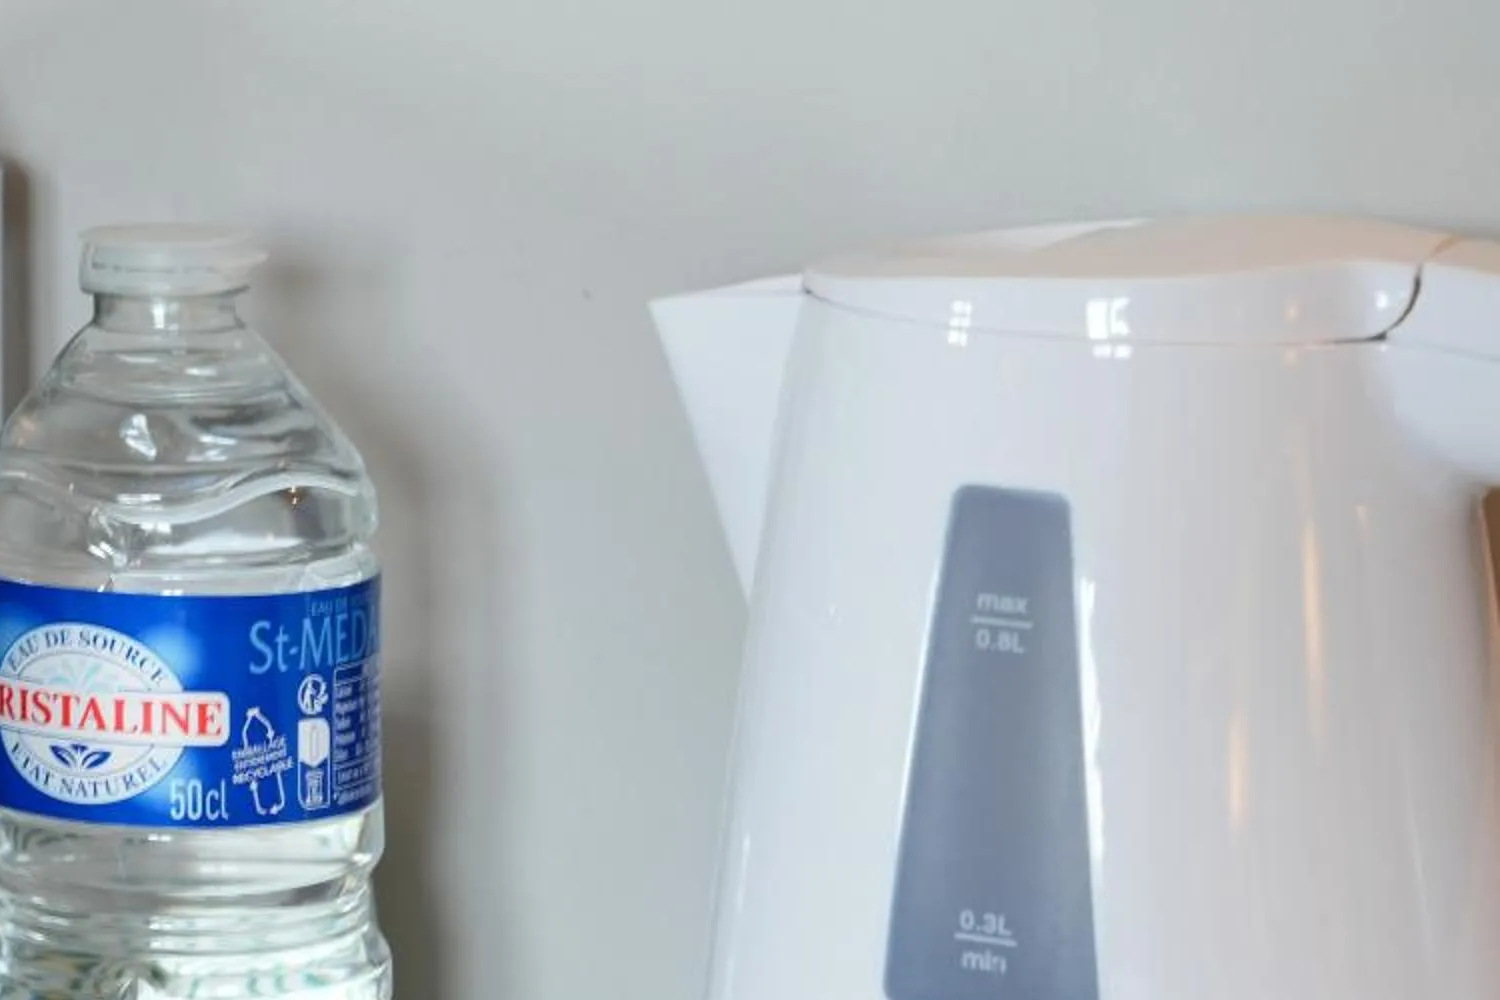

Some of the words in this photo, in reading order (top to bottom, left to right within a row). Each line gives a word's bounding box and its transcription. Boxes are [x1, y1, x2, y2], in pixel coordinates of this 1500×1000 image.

[977, 593, 1028, 614] max
[975, 628, 1025, 654] 0.8L
[8, 634, 40, 671] EAU
[45, 628, 73, 648] DE
[78, 630, 165, 685] SOURCE
[58, 757, 169, 799] NATUREL
[169, 778, 229, 822] 50cl
[959, 908, 1013, 936] 0.3L
[961, 949, 1007, 975] min
